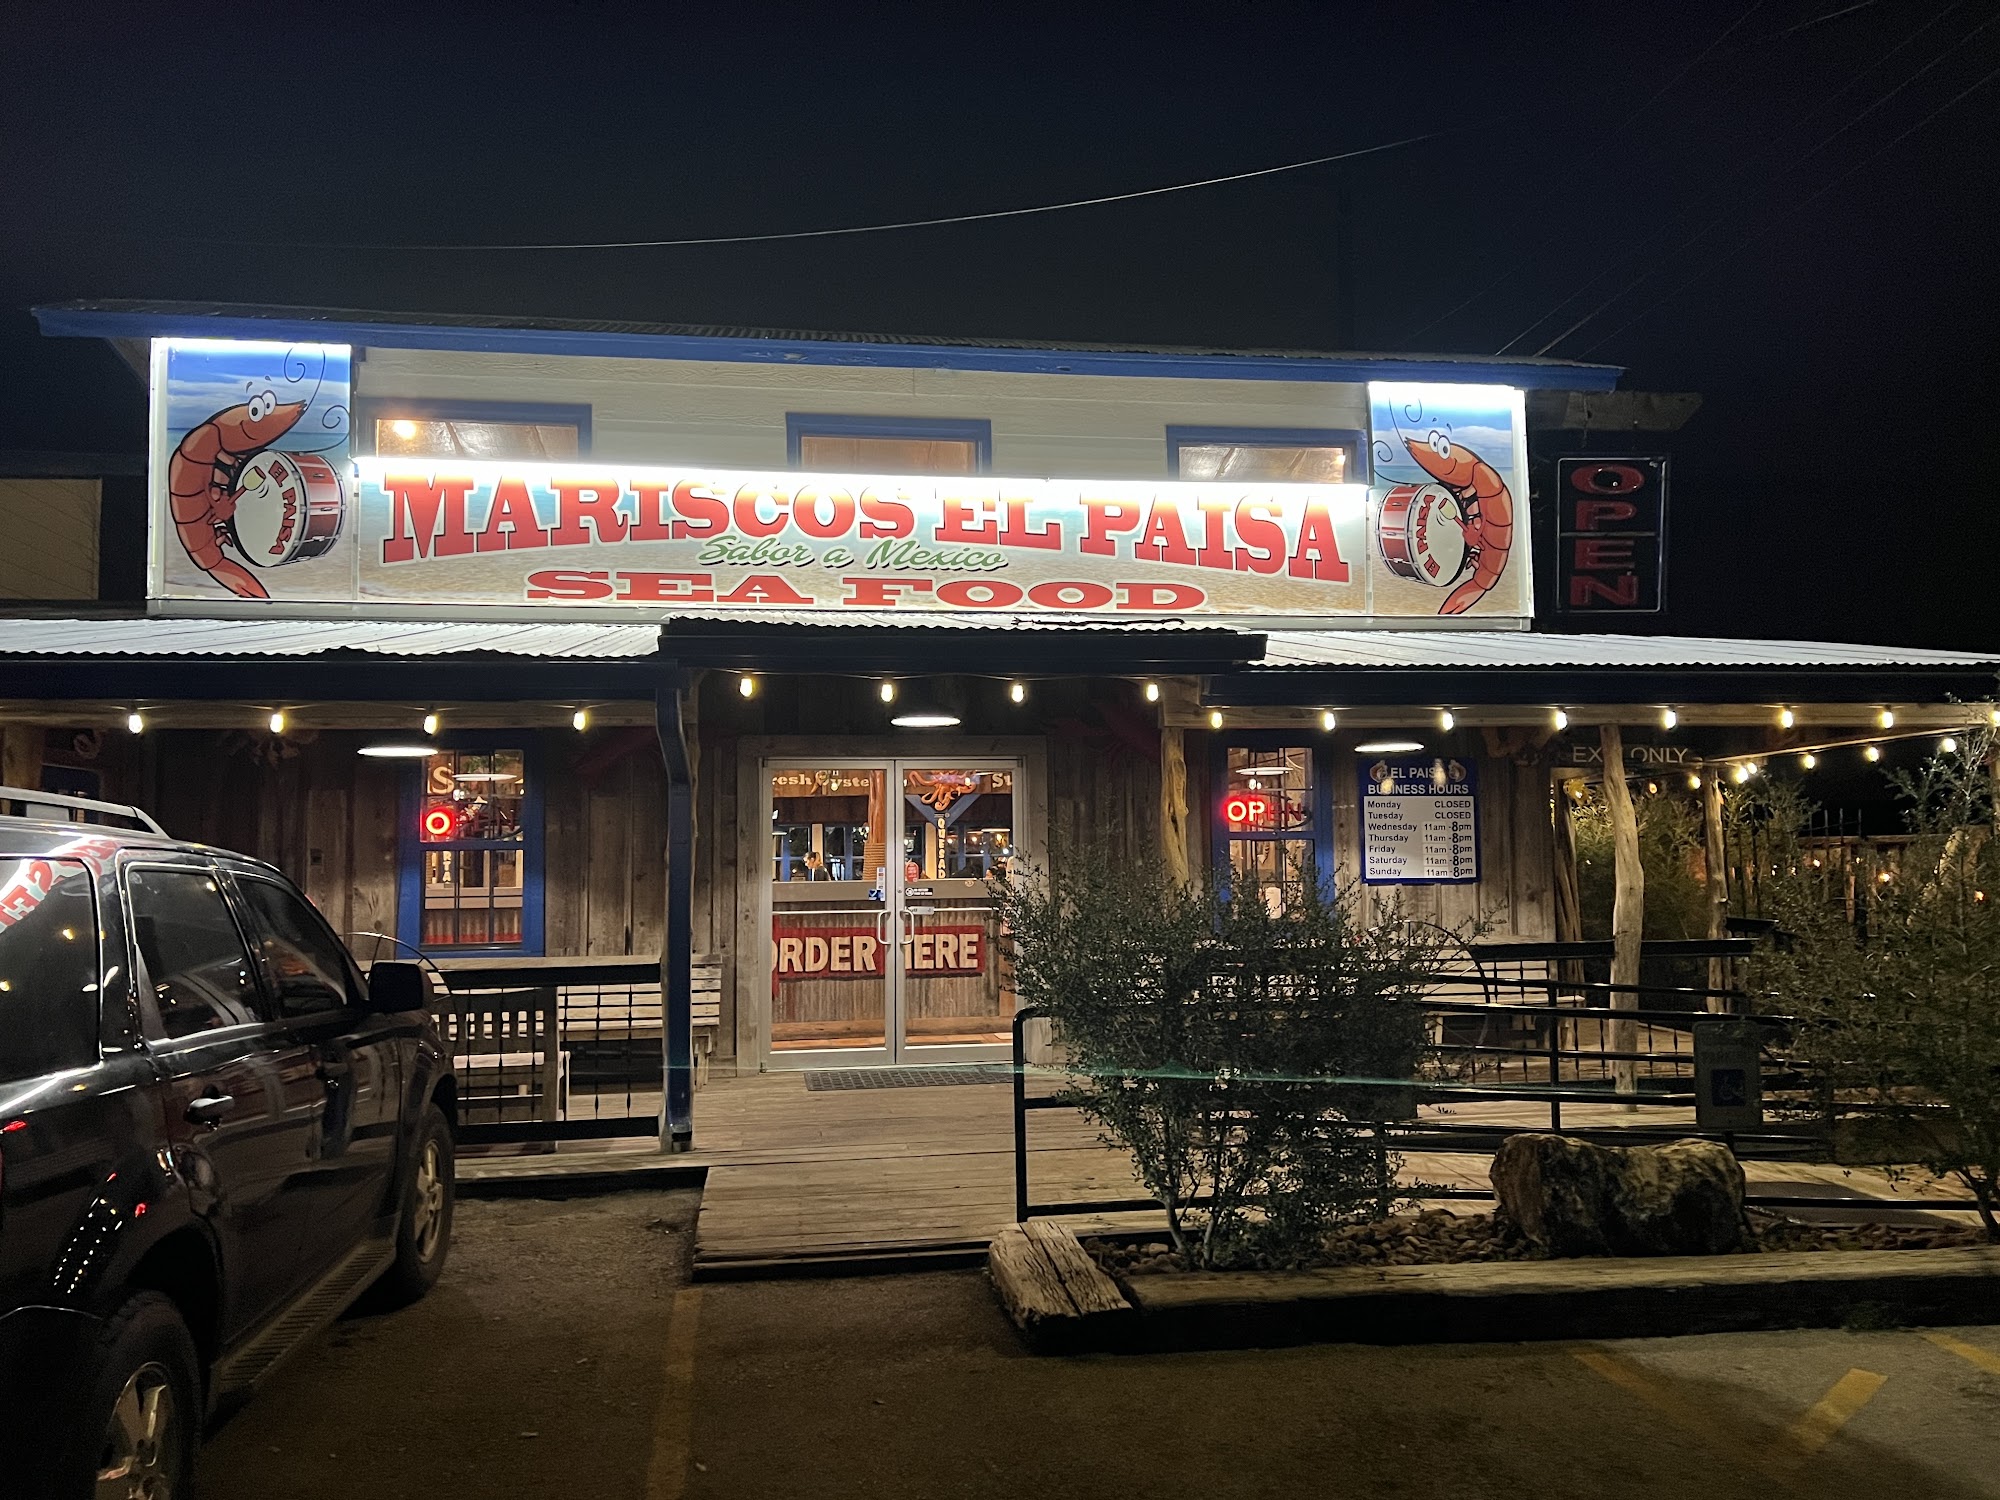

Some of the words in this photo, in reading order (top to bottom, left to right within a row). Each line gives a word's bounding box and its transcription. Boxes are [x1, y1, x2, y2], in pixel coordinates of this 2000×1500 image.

[268, 460, 289, 487] EL
[267, 487, 296, 555] PAISA
[382, 470, 915, 563] MARISCOS
[935, 486, 1062, 551] EL
[1080, 488, 1350, 583] PAISA
[1415, 494, 1436, 555] PAISA
[1570, 463, 1645, 606] OPEN
[699, 535, 815, 567] Sabor
[823, 548, 854, 568] a
[866, 538, 1008, 570] Mexico
[1423, 553, 1441, 579] EL
[526, 570, 815, 605] SEA
[842, 577, 1206, 610] FOOD
[1572, 746, 1602, 763] EX
[1391, 767, 1406, 779] EL
[1409, 767, 1436, 779] PAIS
[772, 774, 812, 785] resh
[1367, 784, 1425, 795] BUINESS
[1428, 784, 1469, 795] HOURS
[1367, 801, 1401, 809] Monday
[1434, 800, 1470, 808] CLOSED
[1368, 812, 1403, 821] Tuesday
[1434, 811, 1471, 819] CLOSED
[1368, 823, 1417, 832] Wednesday
[1369, 834, 1408, 843] Thursday
[1369, 845, 1395, 854] Friday
[1369, 856, 1407, 865] Saturday
[1369, 867, 1401, 876] Sunday
